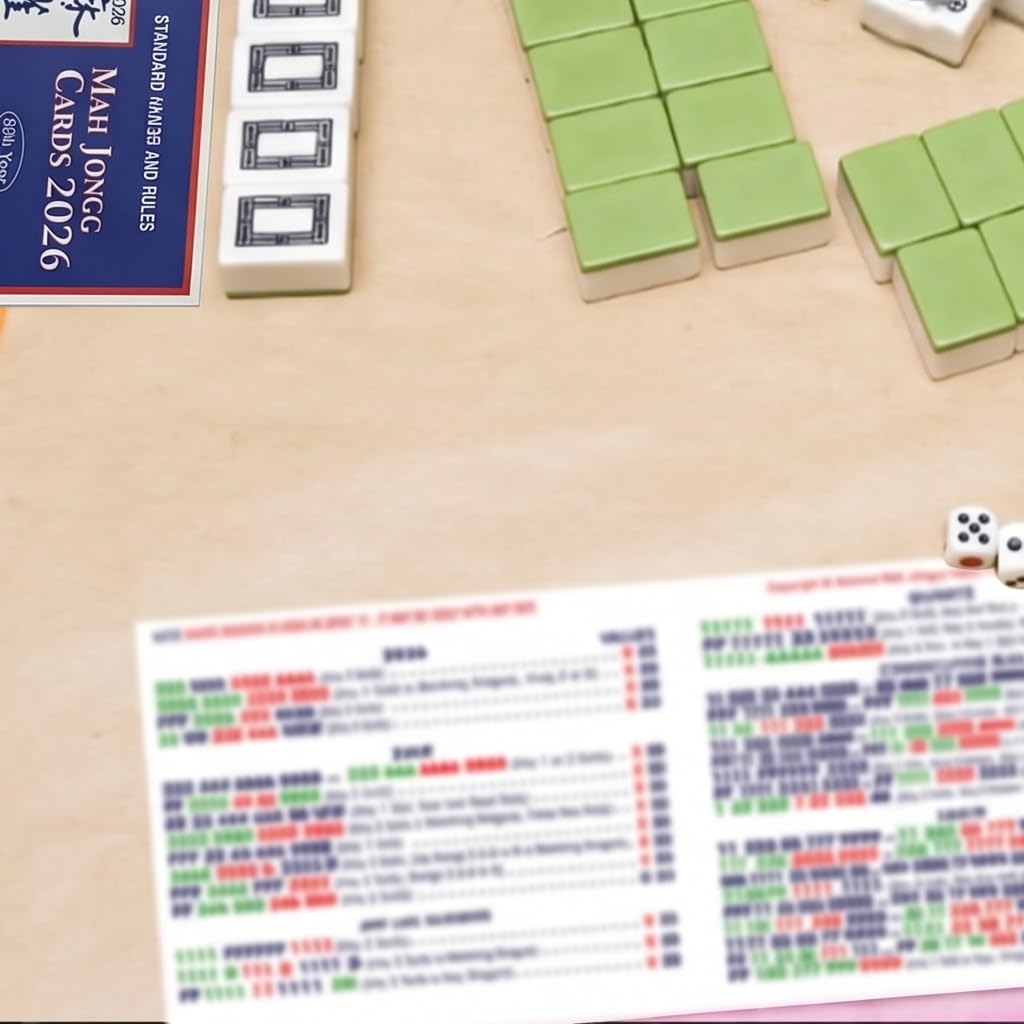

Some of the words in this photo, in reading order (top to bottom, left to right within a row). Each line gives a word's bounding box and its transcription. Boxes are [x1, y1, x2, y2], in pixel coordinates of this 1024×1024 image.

[150, 15, 169, 91] STANDARD
[87, 67, 118, 134] MAH
[79, 143, 112, 233] JONGG
[143, 151, 158, 180] AND
[40, 176, 76, 271] 2026
[139, 186, 157, 231] RULES
